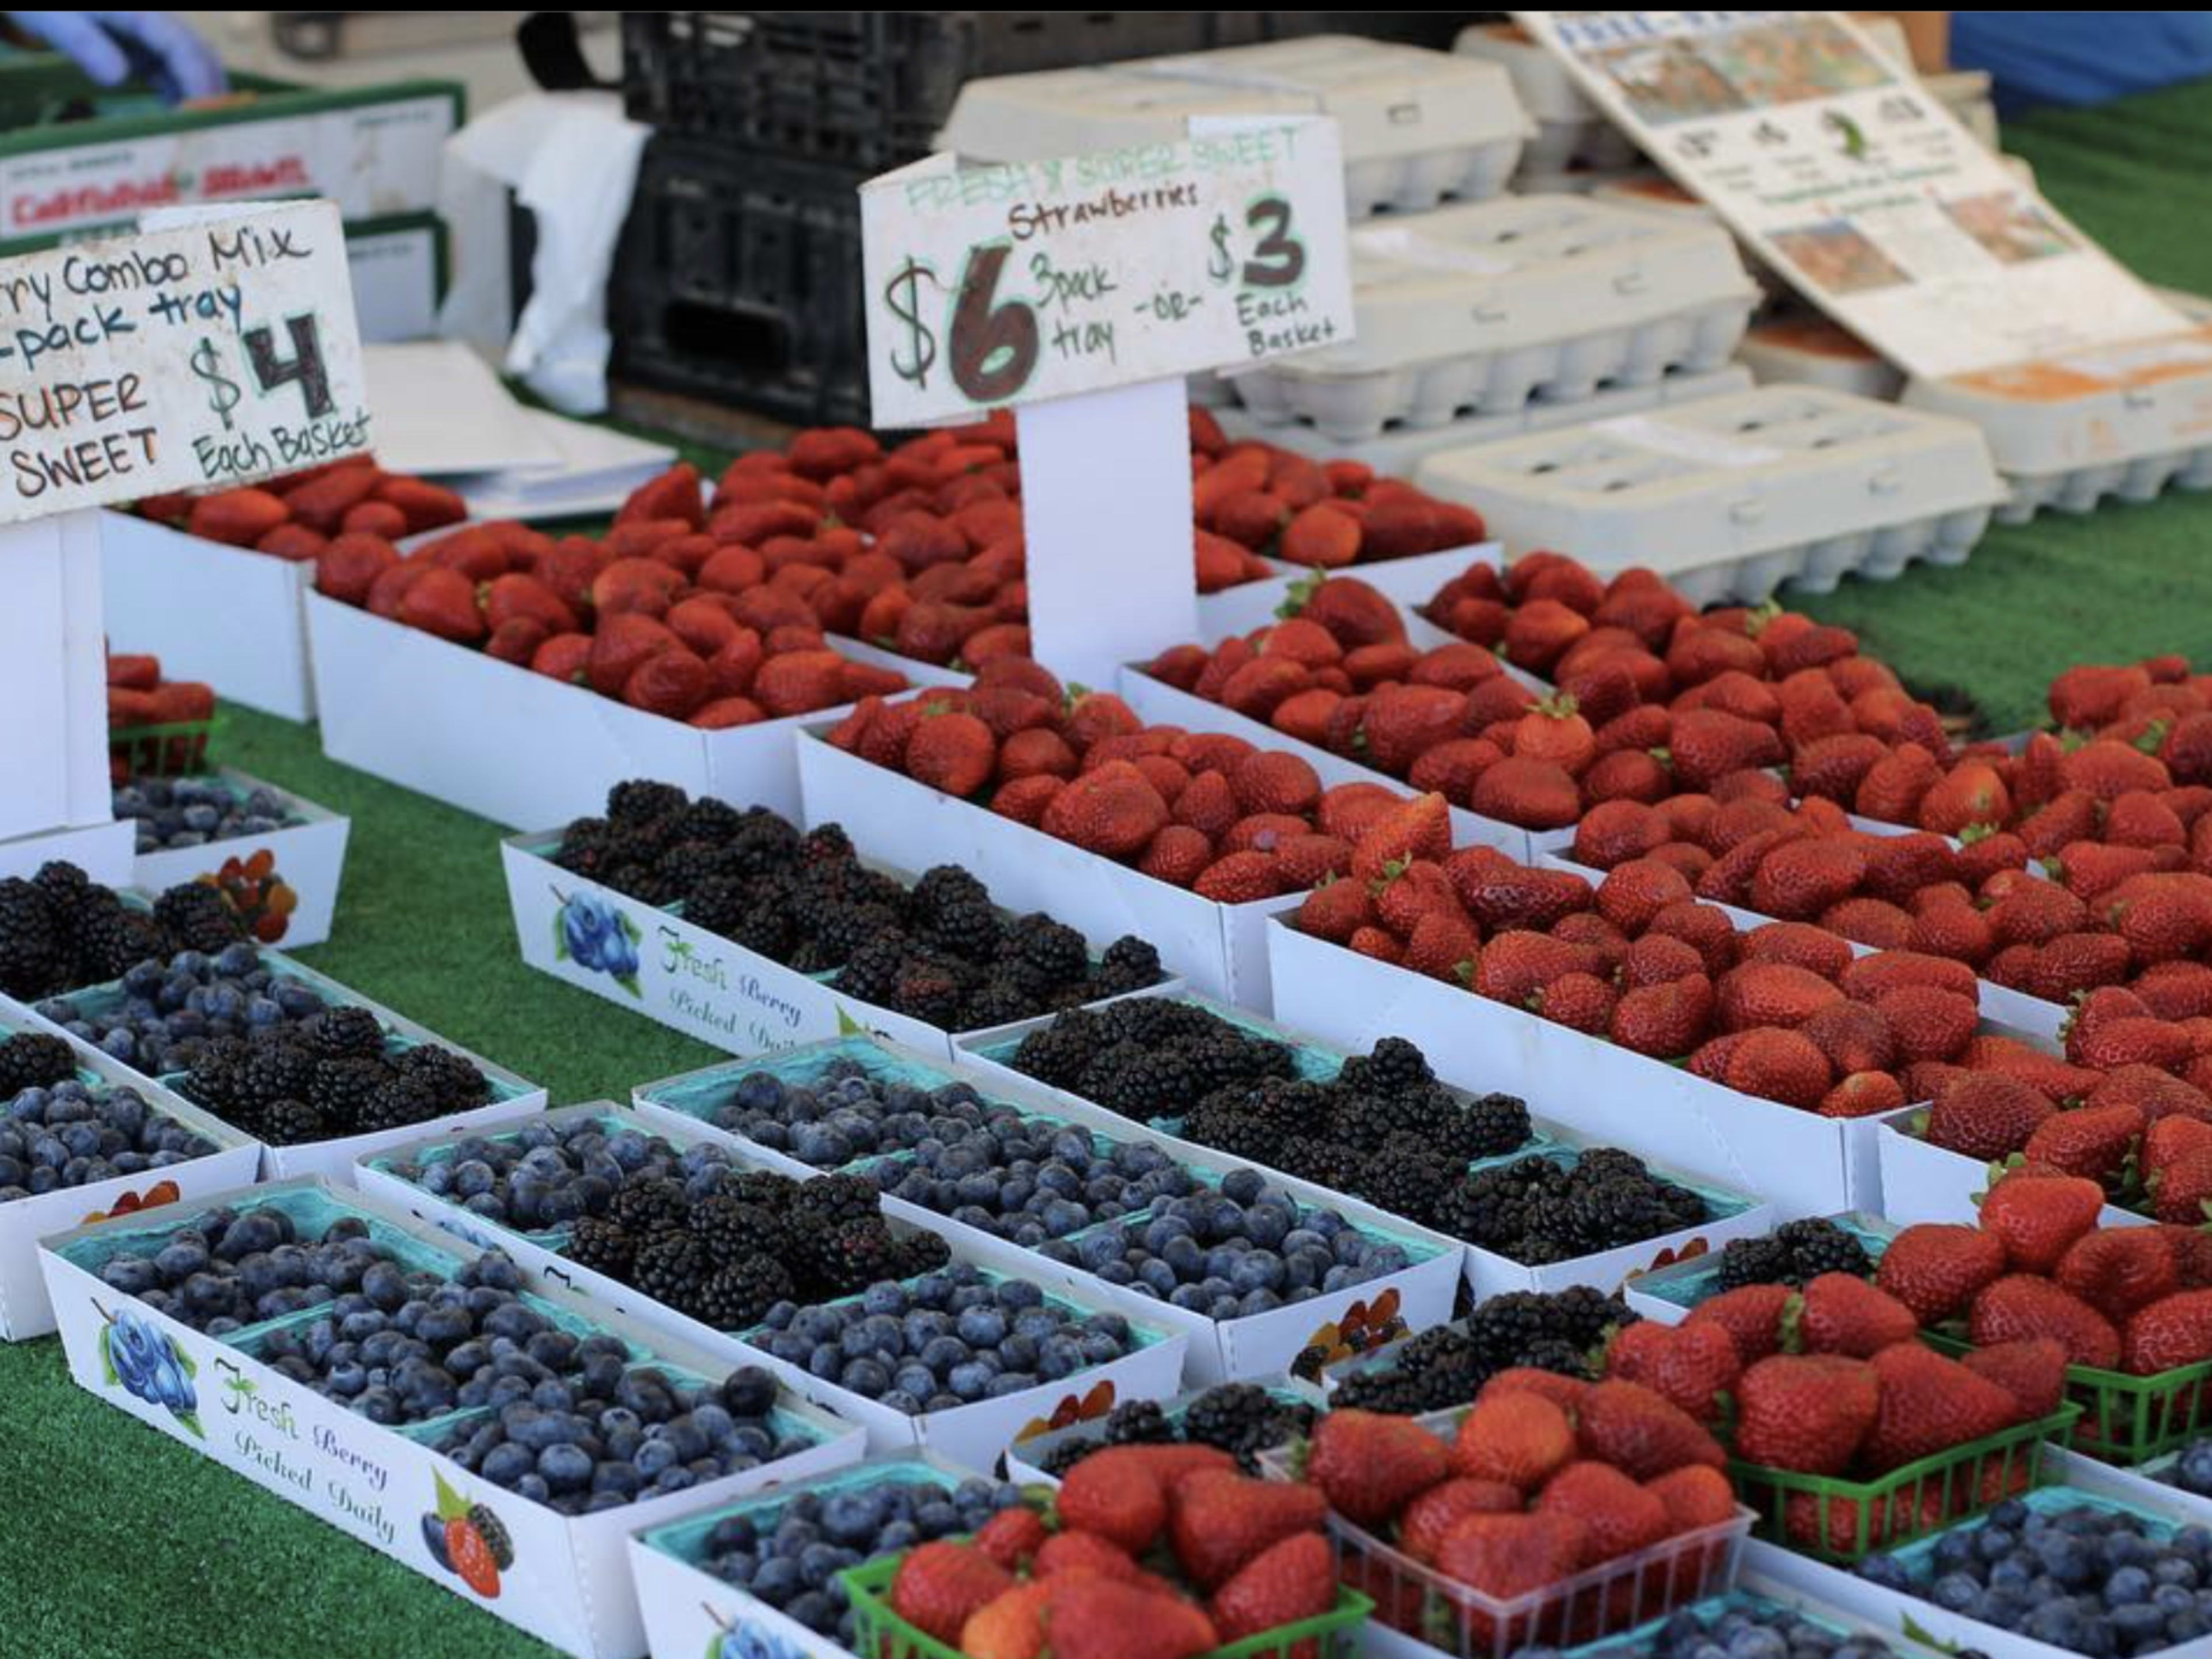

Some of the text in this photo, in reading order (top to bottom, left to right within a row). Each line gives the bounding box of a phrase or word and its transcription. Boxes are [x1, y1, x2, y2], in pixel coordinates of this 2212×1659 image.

[1191, 122, 1300, 170] SWEET
[1009, 182, 1198, 239] Strawberries
[0, 227, 312, 323] ry Combo Mix
[149, 283, 244, 334] tray
[1234, 291, 1308, 327] Each
[1248, 317, 1336, 356] Basket
[1052, 318, 1115, 365] tray
[0, 373, 146, 441] SUPER
[10, 427, 156, 497] SWEET
[192, 407, 370, 479] Each Basket
[658, 925, 801, 1027] Fresh Berry
[669, 987, 737, 1033] Picked
[214, 1357, 387, 1492] Fresh Berry
[235, 1430, 395, 1544] Picked Daily
